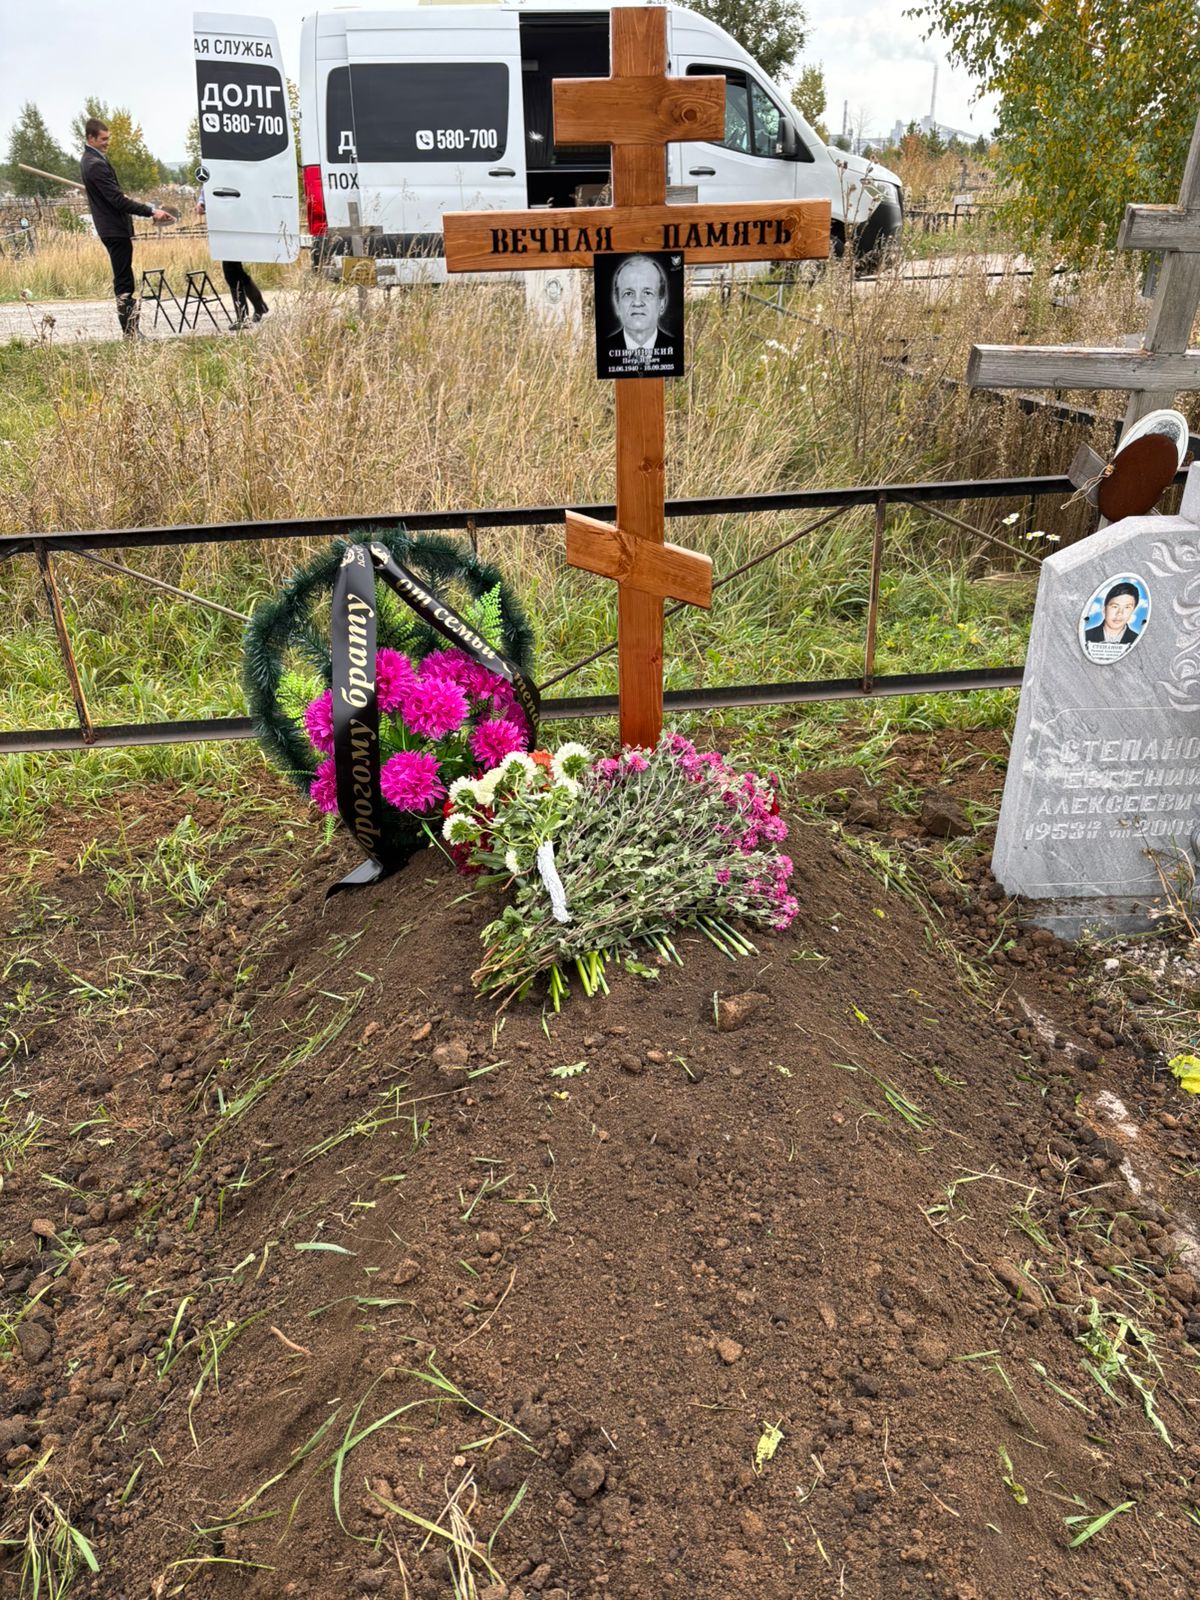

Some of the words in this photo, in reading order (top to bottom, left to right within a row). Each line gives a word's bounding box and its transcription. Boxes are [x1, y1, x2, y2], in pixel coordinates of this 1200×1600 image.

[214, 39, 273, 59] СЛУЖБА
[201, 83, 281, 111] ДОЛГ
[222, 113, 284, 135] 580-700
[338, 130, 357, 157] Д
[436, 128, 498, 150] 580-700
[328, 172, 360, 190] ПОХ
[489, 226, 615, 254] ВЕЧНАЯ
[661, 219, 793, 249] ПАМЯТЬ
[396, 578, 432, 608] от
[434, 607, 496, 660] семьи
[340, 593, 375, 709] брату
[350, 718, 381, 856] орогому
